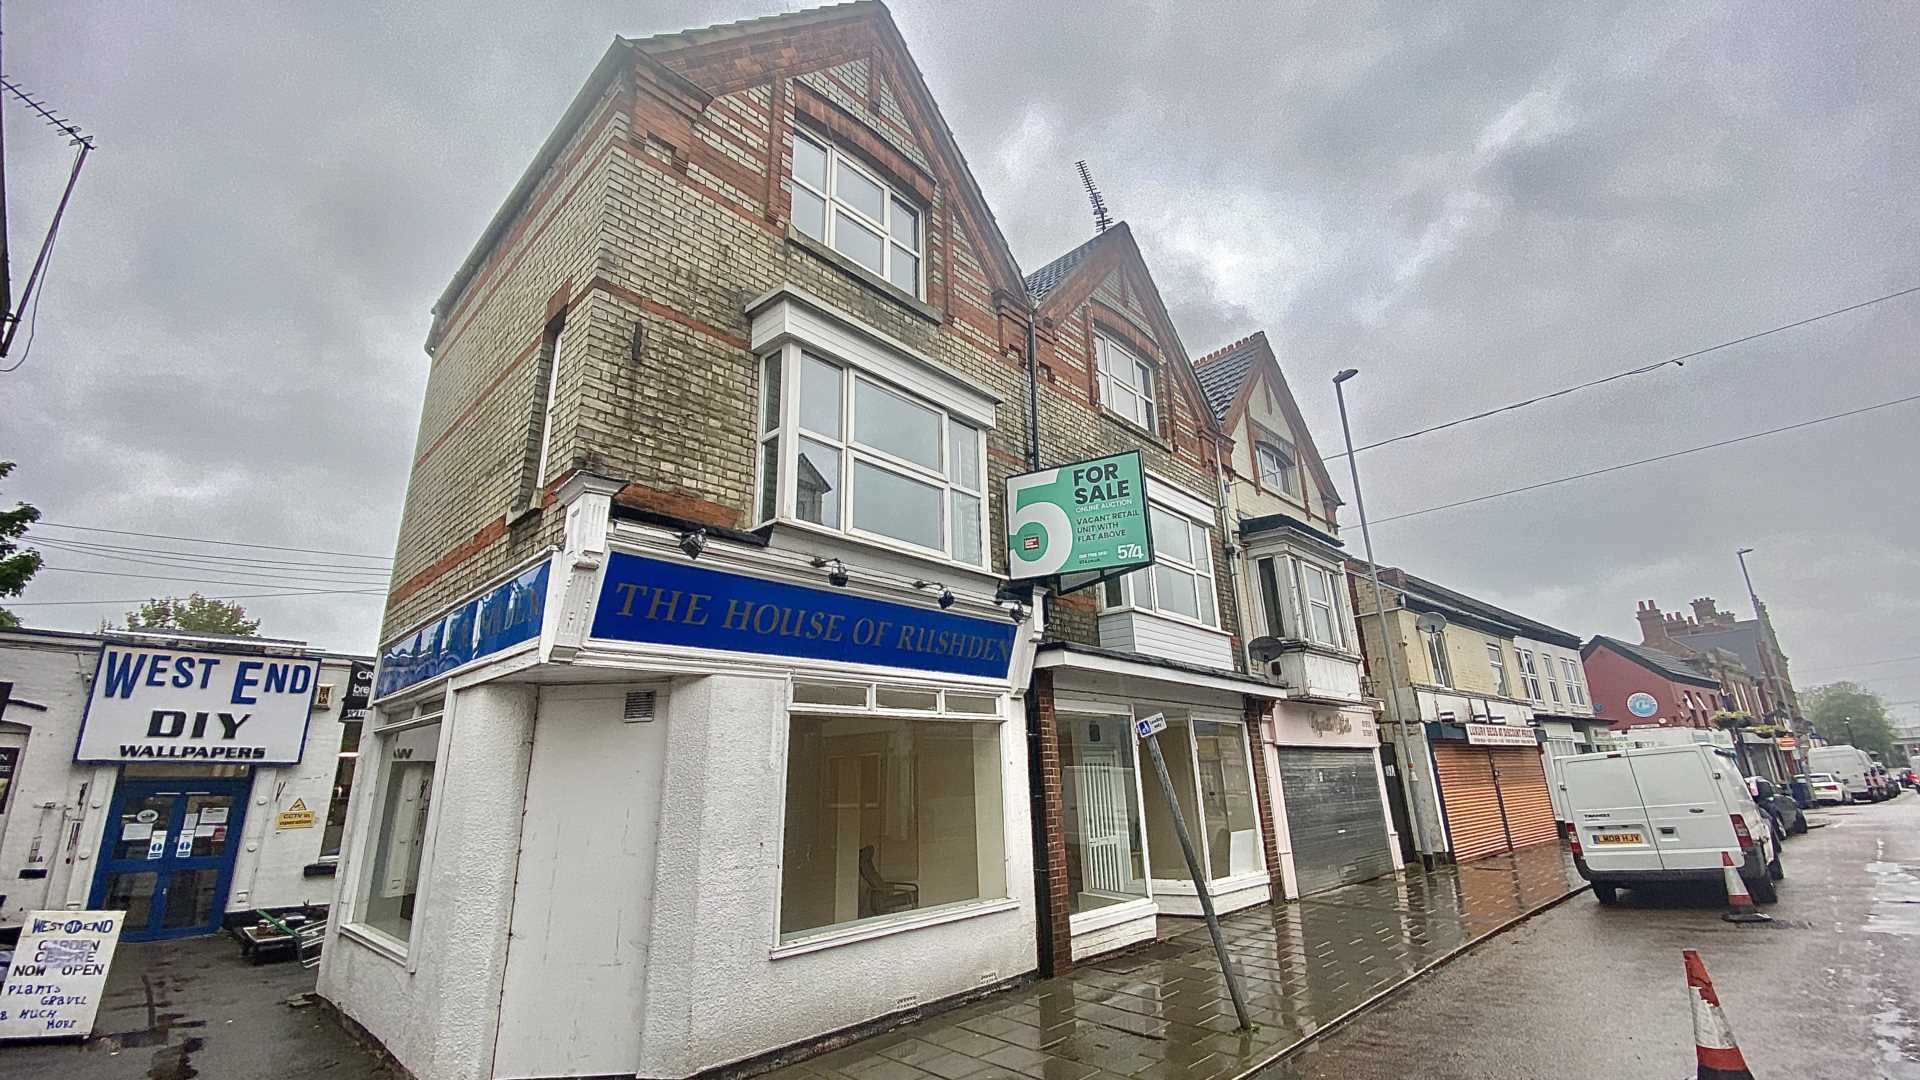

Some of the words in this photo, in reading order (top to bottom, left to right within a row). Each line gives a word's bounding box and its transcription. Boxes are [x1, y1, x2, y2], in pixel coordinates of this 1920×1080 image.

[1073, 463, 1119, 487] FOR
[1075, 480, 1130, 505] SALE
[1076, 503, 1100, 513] ONLINE
[1102, 498, 1132, 510] AUCTION
[1077, 514, 1112, 526] VACANT
[1112, 509, 1140, 520] RETAIL
[1077, 525, 1097, 534] UNIT
[1098, 521, 1118, 532] WITH
[1078, 534, 1096, 543] FLAT
[1098, 529, 1126, 540] ABOVE
[1117, 543, 1144, 561] 574
[615, 583, 712, 626] THE
[722, 598, 847, 642] HOUSE
[852, 617, 893, 647] OF
[896, 624, 1013, 663] RUSHDEN
[105, 651, 220, 699] WEST
[230, 660, 312, 705] END
[147, 710, 251, 740] DIY
[119, 744, 266, 759] WALLPAPERS
[32, 918, 63, 934] WEST
[83, 919, 114, 934] END
[34, 951, 95, 963] CERE
[13, 965, 47, 977] NOW
[62, 964, 105, 976] OPEN
